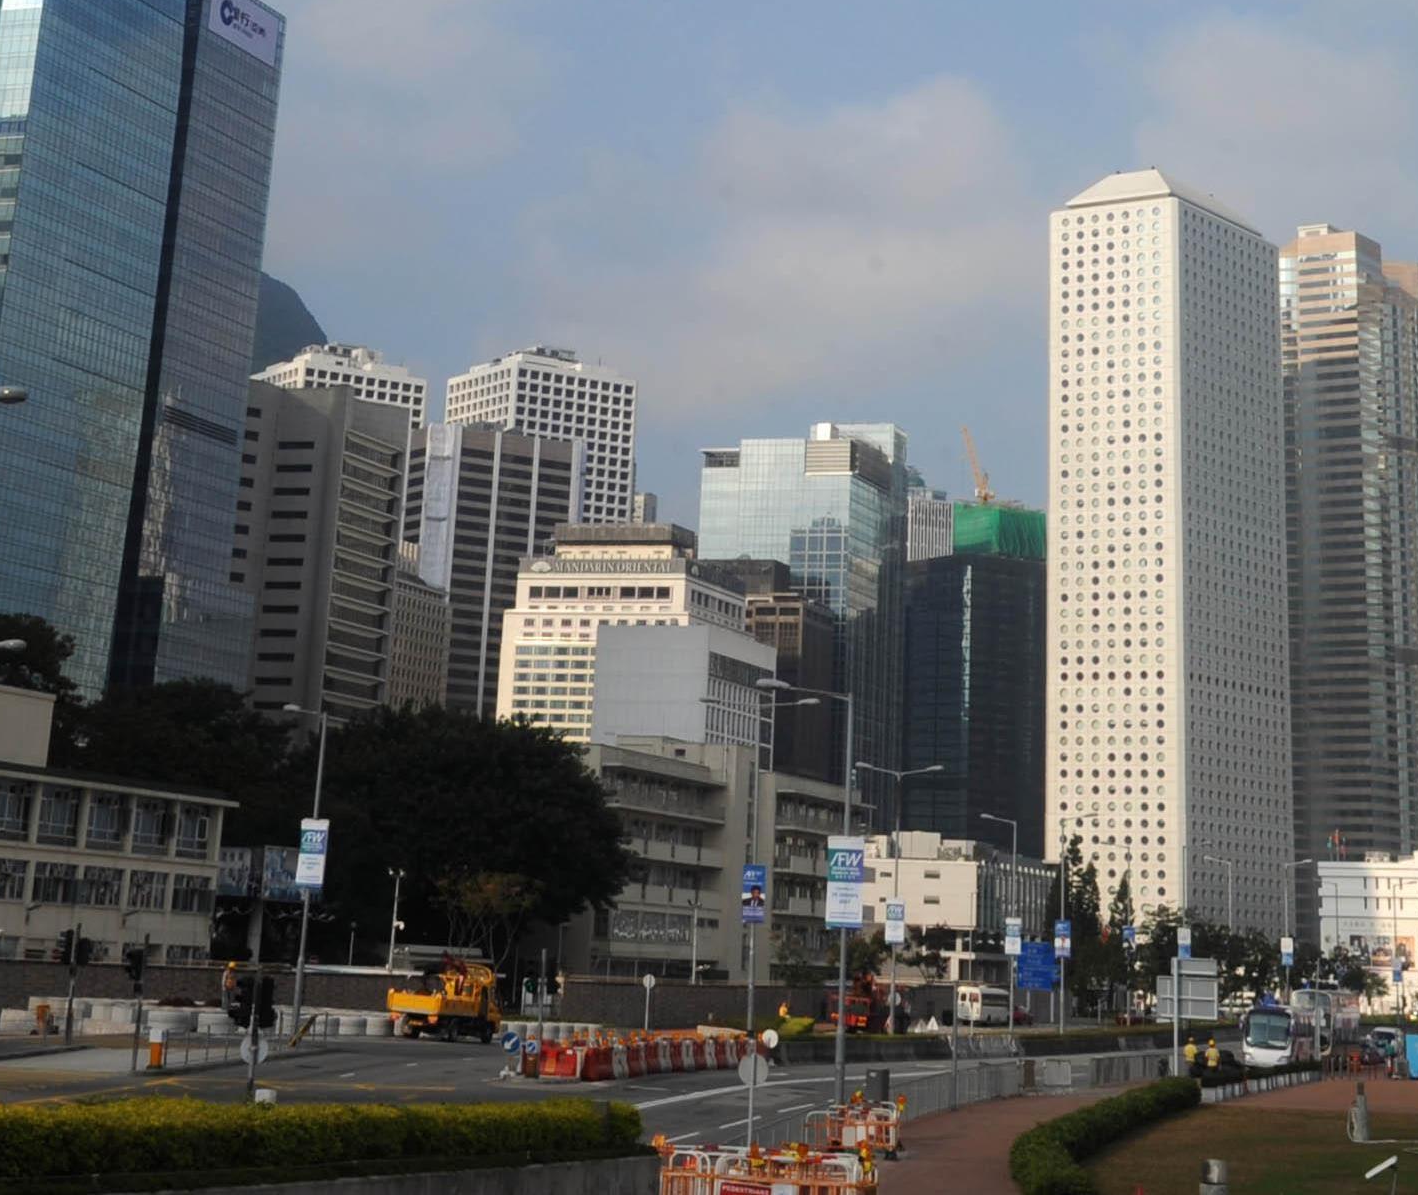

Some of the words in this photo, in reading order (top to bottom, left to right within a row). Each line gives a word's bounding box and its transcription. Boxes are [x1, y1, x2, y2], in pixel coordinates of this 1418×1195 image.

[555, 561, 615, 572] MANDARIN
[617, 561, 671, 572] ORIENTAL
[830, 852, 863, 867] IFW
